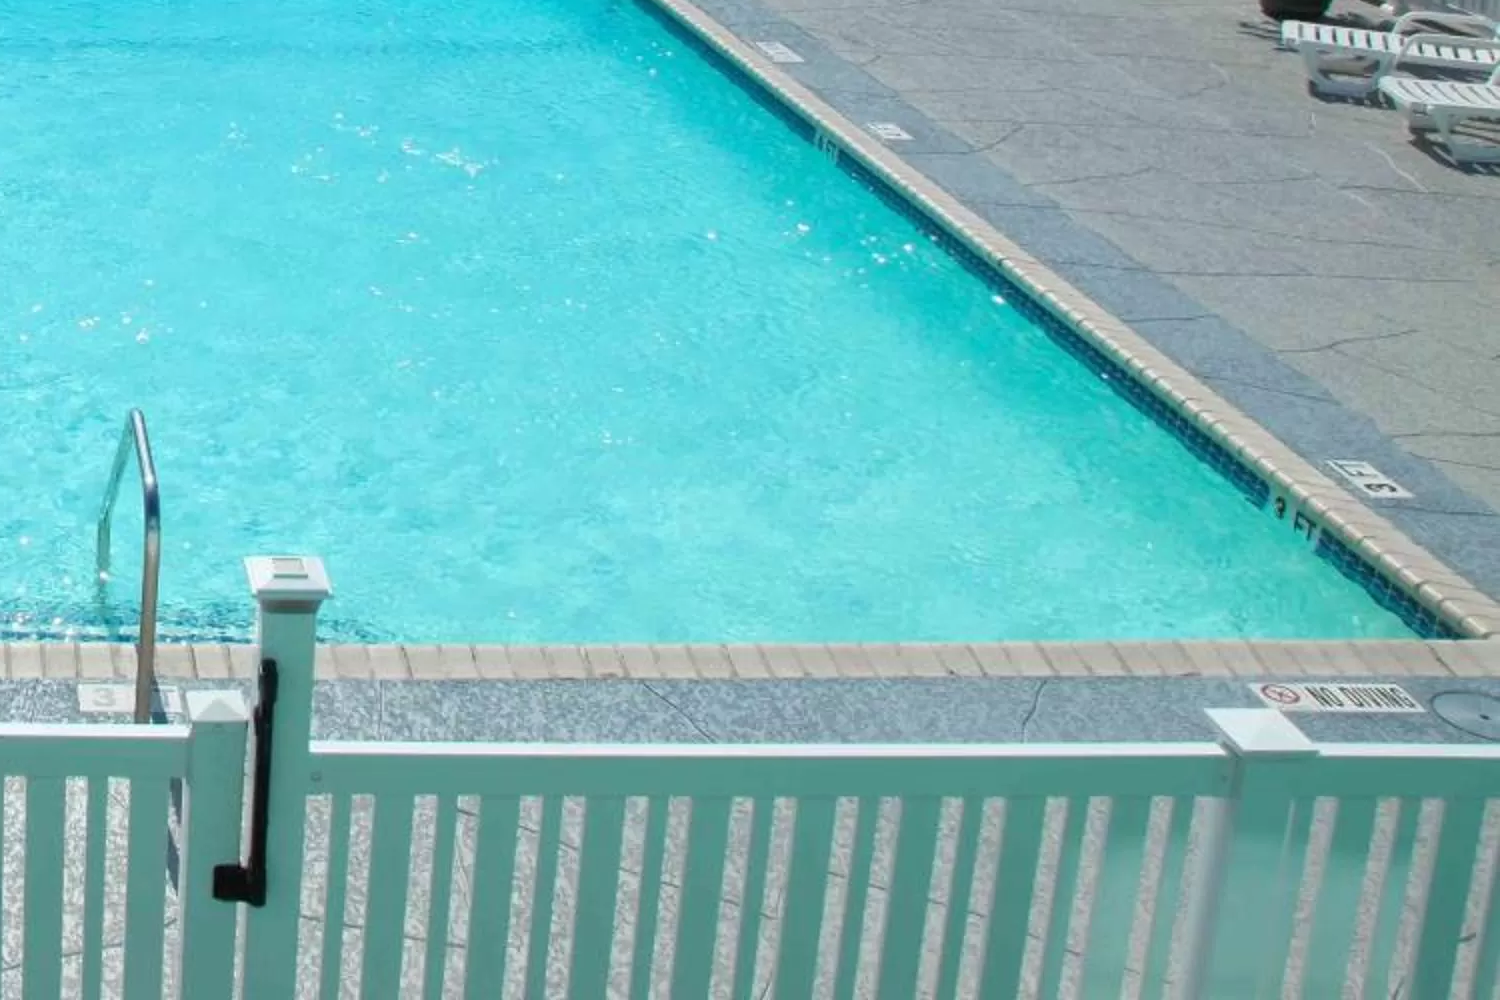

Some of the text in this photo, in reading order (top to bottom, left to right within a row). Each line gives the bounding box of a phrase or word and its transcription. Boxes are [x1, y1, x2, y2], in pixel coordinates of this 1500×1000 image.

[1273, 495, 1317, 541] 3 FT
[92, 687, 117, 708] 3
[1303, 685, 1418, 709] NO DIVING
